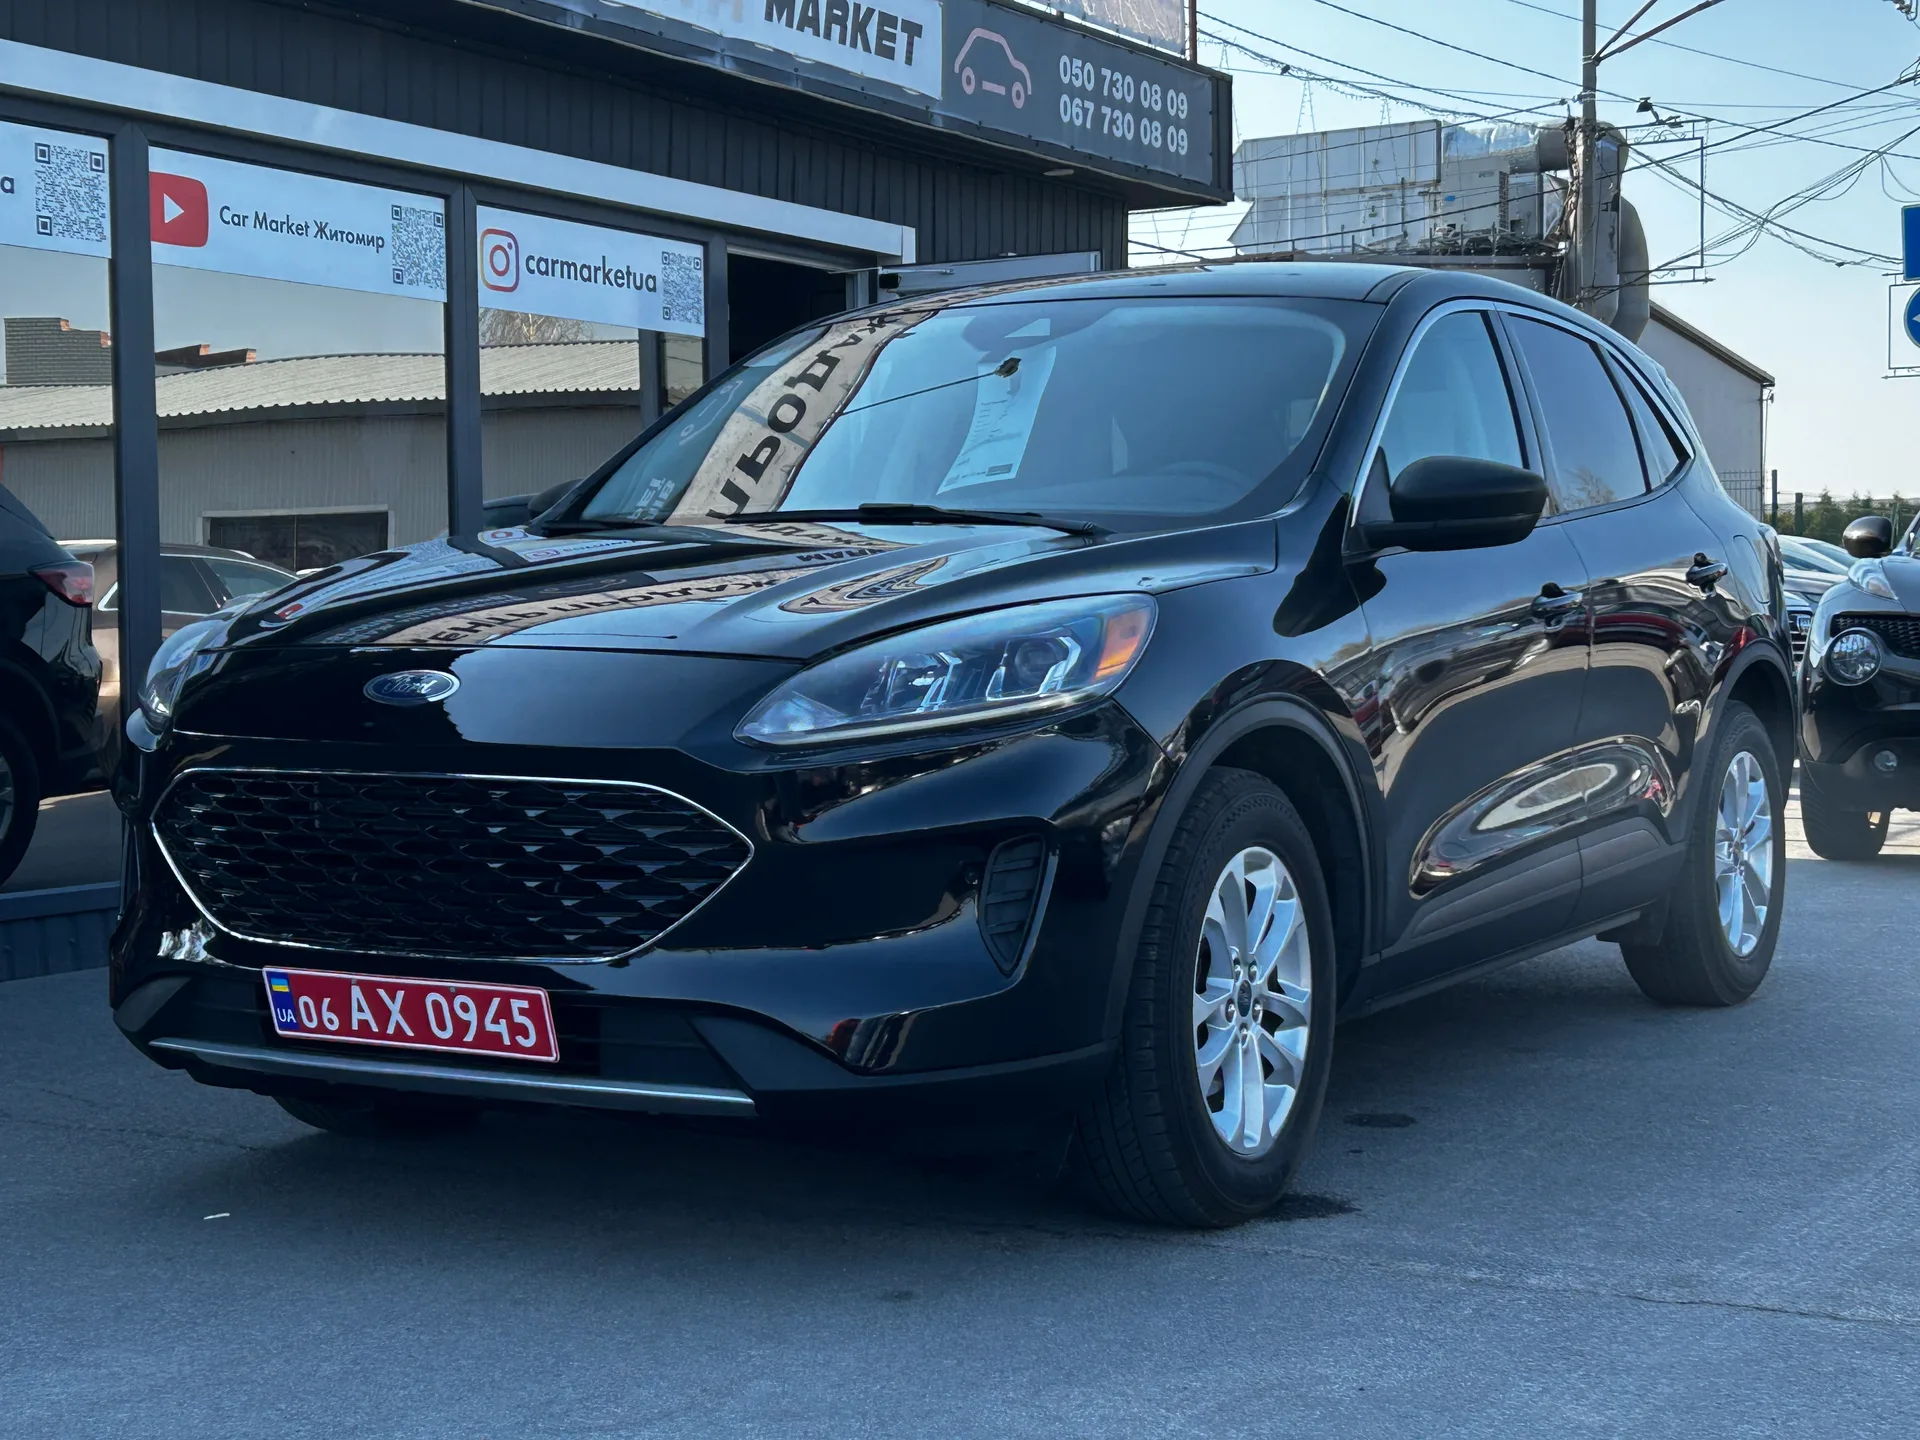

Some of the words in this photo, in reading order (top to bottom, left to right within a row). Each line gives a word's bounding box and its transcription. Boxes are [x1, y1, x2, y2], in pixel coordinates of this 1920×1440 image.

[764, 0, 923, 66] MARKET
[1059, 55, 1095, 91] 050
[1101, 68, 1134, 103] 730
[1140, 80, 1161, 112] 08
[1167, 89, 1188, 119] 09
[1059, 94, 1094, 129] 067
[1101, 105, 1134, 141] 730
[1140, 117, 1161, 148] 08
[1167, 125, 1188, 155] 09
[219, 205, 249, 228] Car
[253, 211, 310, 238] Market
[313, 220, 385, 254] Житомир
[525, 254, 657, 293] carmarketua
[382, 674, 438, 694] Ford
[276, 1008, 297, 1023] UA
[298, 995, 340, 1031] 06
[351, 985, 415, 1037] AX
[425, 992, 536, 1048] 0945
